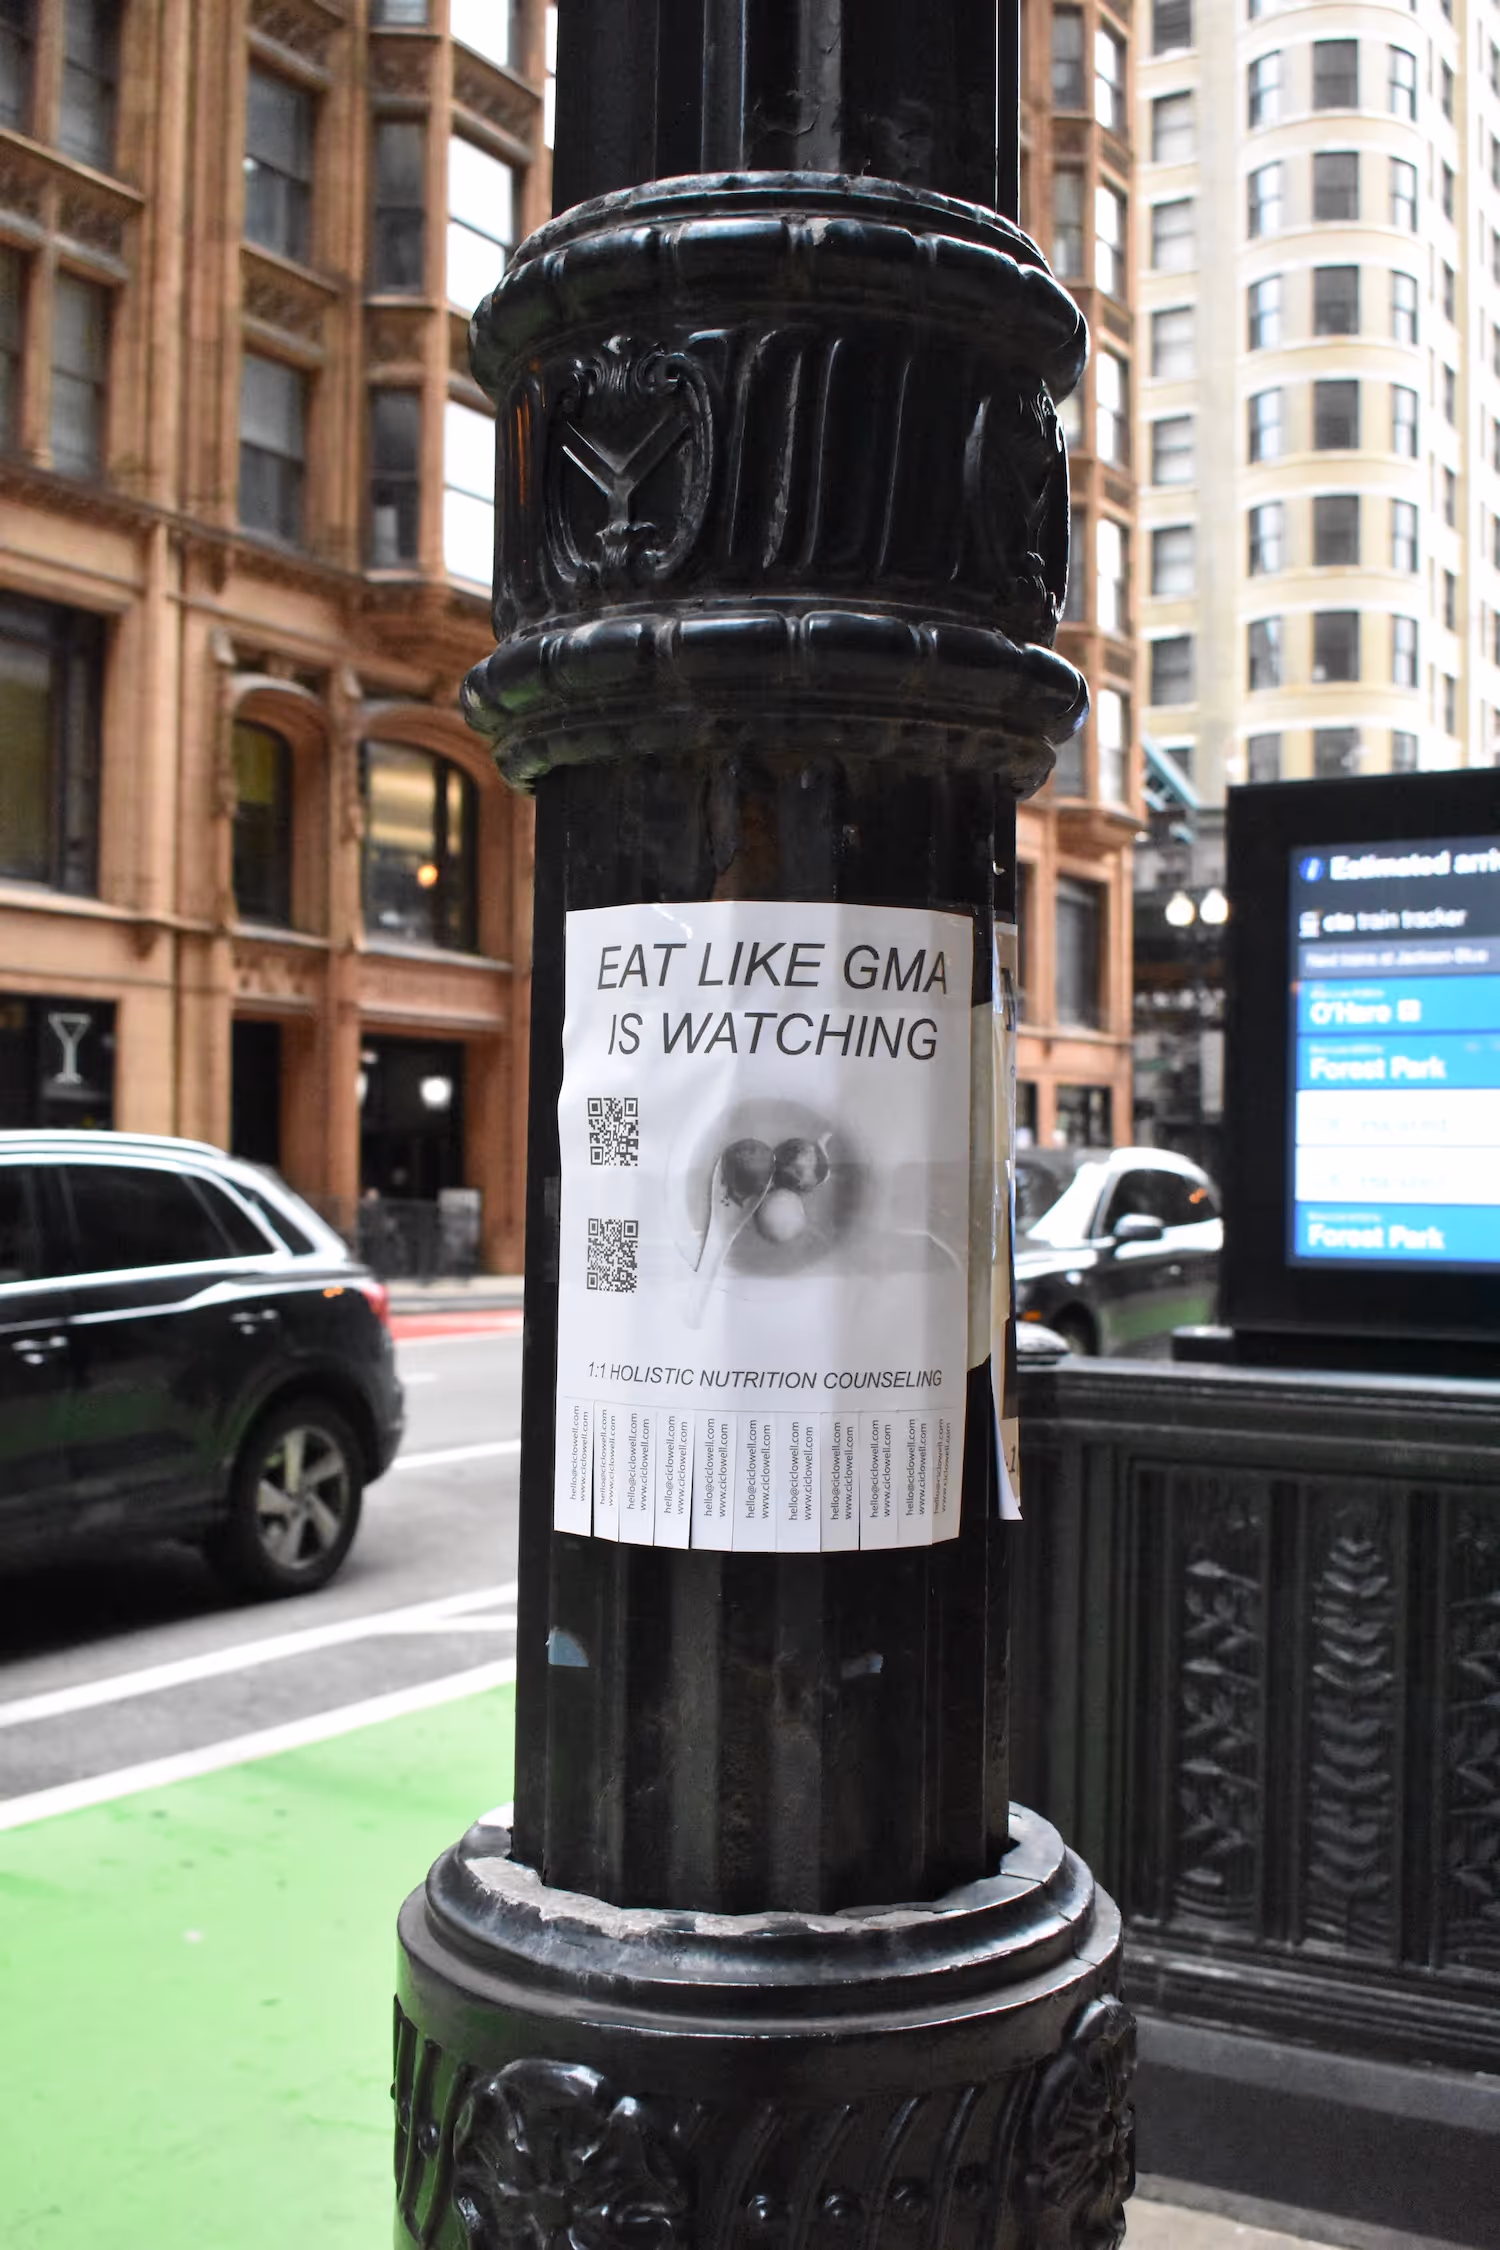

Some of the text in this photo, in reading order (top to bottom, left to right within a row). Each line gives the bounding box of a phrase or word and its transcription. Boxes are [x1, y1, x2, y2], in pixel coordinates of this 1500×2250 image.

[597, 941, 948, 995] EAT LIKE GMA
[607, 1011, 938, 1061] IS WATCHING
[1310, 1055, 1447, 1080] Forest Park
[1308, 1223, 1446, 1250] Forest Park
[587, 1361, 943, 1390] 1:1 HOLISTIC NUTRITION COUNSELING
[626, 1412, 638, 1510] hello@ciclowell.com
[640, 1418, 650, 1512] www.ciclowell.com
[664, 1415, 676, 1514] hello@ciclowell.com
[677, 1421, 688, 1515] www.ciclowell.com
[703, 1418, 715, 1517] hello@ciclowell.com
[719, 1423, 729, 1518] www.ciclowell.com
[745, 1419, 757, 1519] hello@ciclowell.com
[761, 1423, 771, 1520] www.ciclowell.com
[788, 1421, 800, 1521] hello@ciclowell.com
[802, 1425, 814, 1521] www.ciclowell.com
[830, 1421, 841, 1520] hello@ciclowell.com
[844, 1425, 854, 1521] www.ciclowell.com
[869, 1419, 880, 1519] hello@ciclowell.com
[883, 1423, 892, 1518] www.ciclowell.com
[906, 1418, 916, 1517] hello@ciclowell.com
[918, 1422, 927, 1516] www.ciclowell.com
